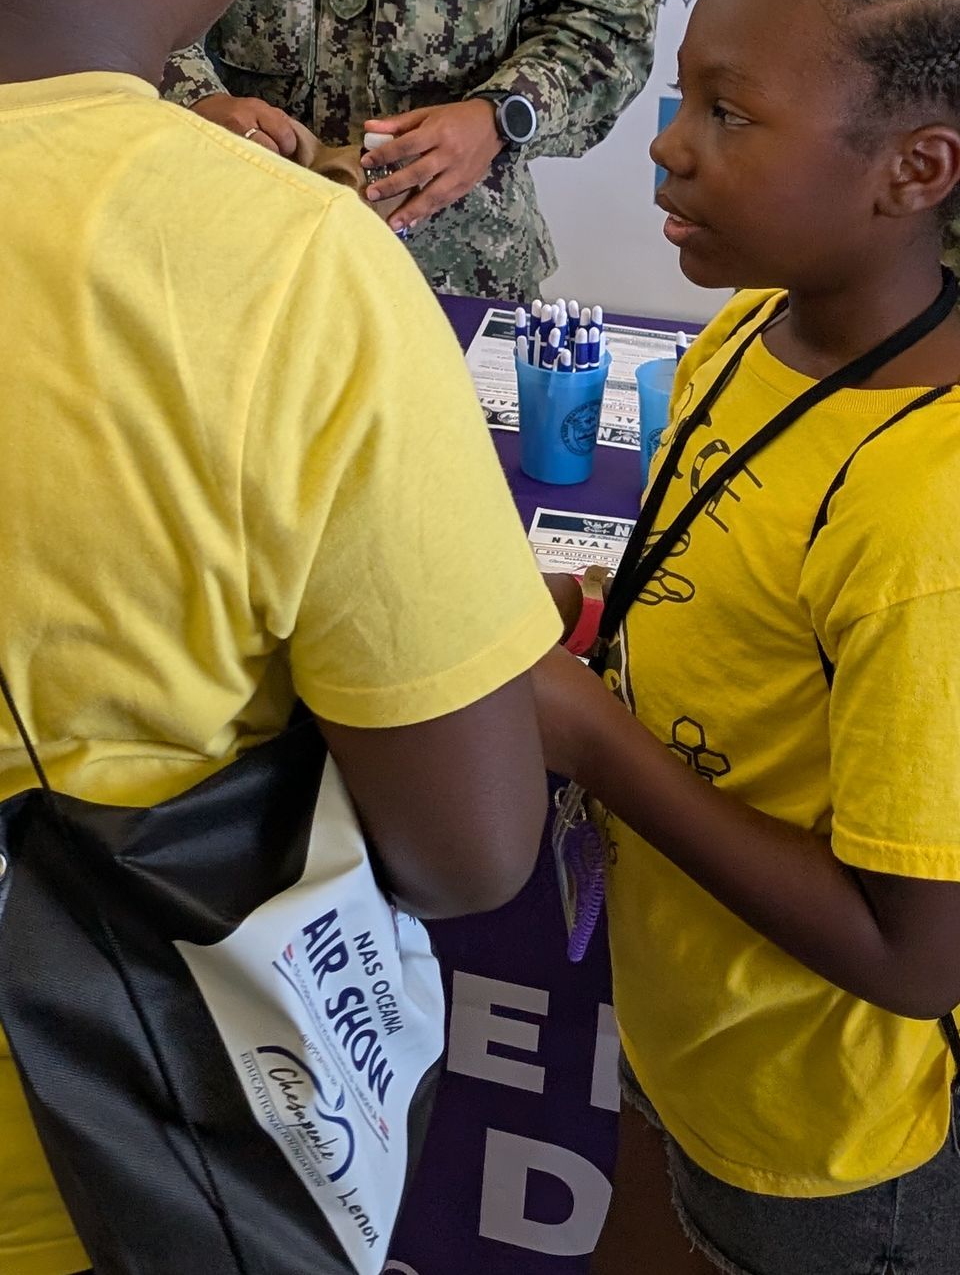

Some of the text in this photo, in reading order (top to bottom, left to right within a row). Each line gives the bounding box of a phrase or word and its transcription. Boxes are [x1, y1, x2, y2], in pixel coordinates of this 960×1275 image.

[551, 536, 612, 550] NAVAL
[302, 908, 350, 991] AIR
[353, 931, 404, 1036] NAS OCEANA
[324, 986, 395, 1106] SHOW
[269, 1067, 339, 1161] Chesapeake
[336, 1187, 380, 1248] Lenox
